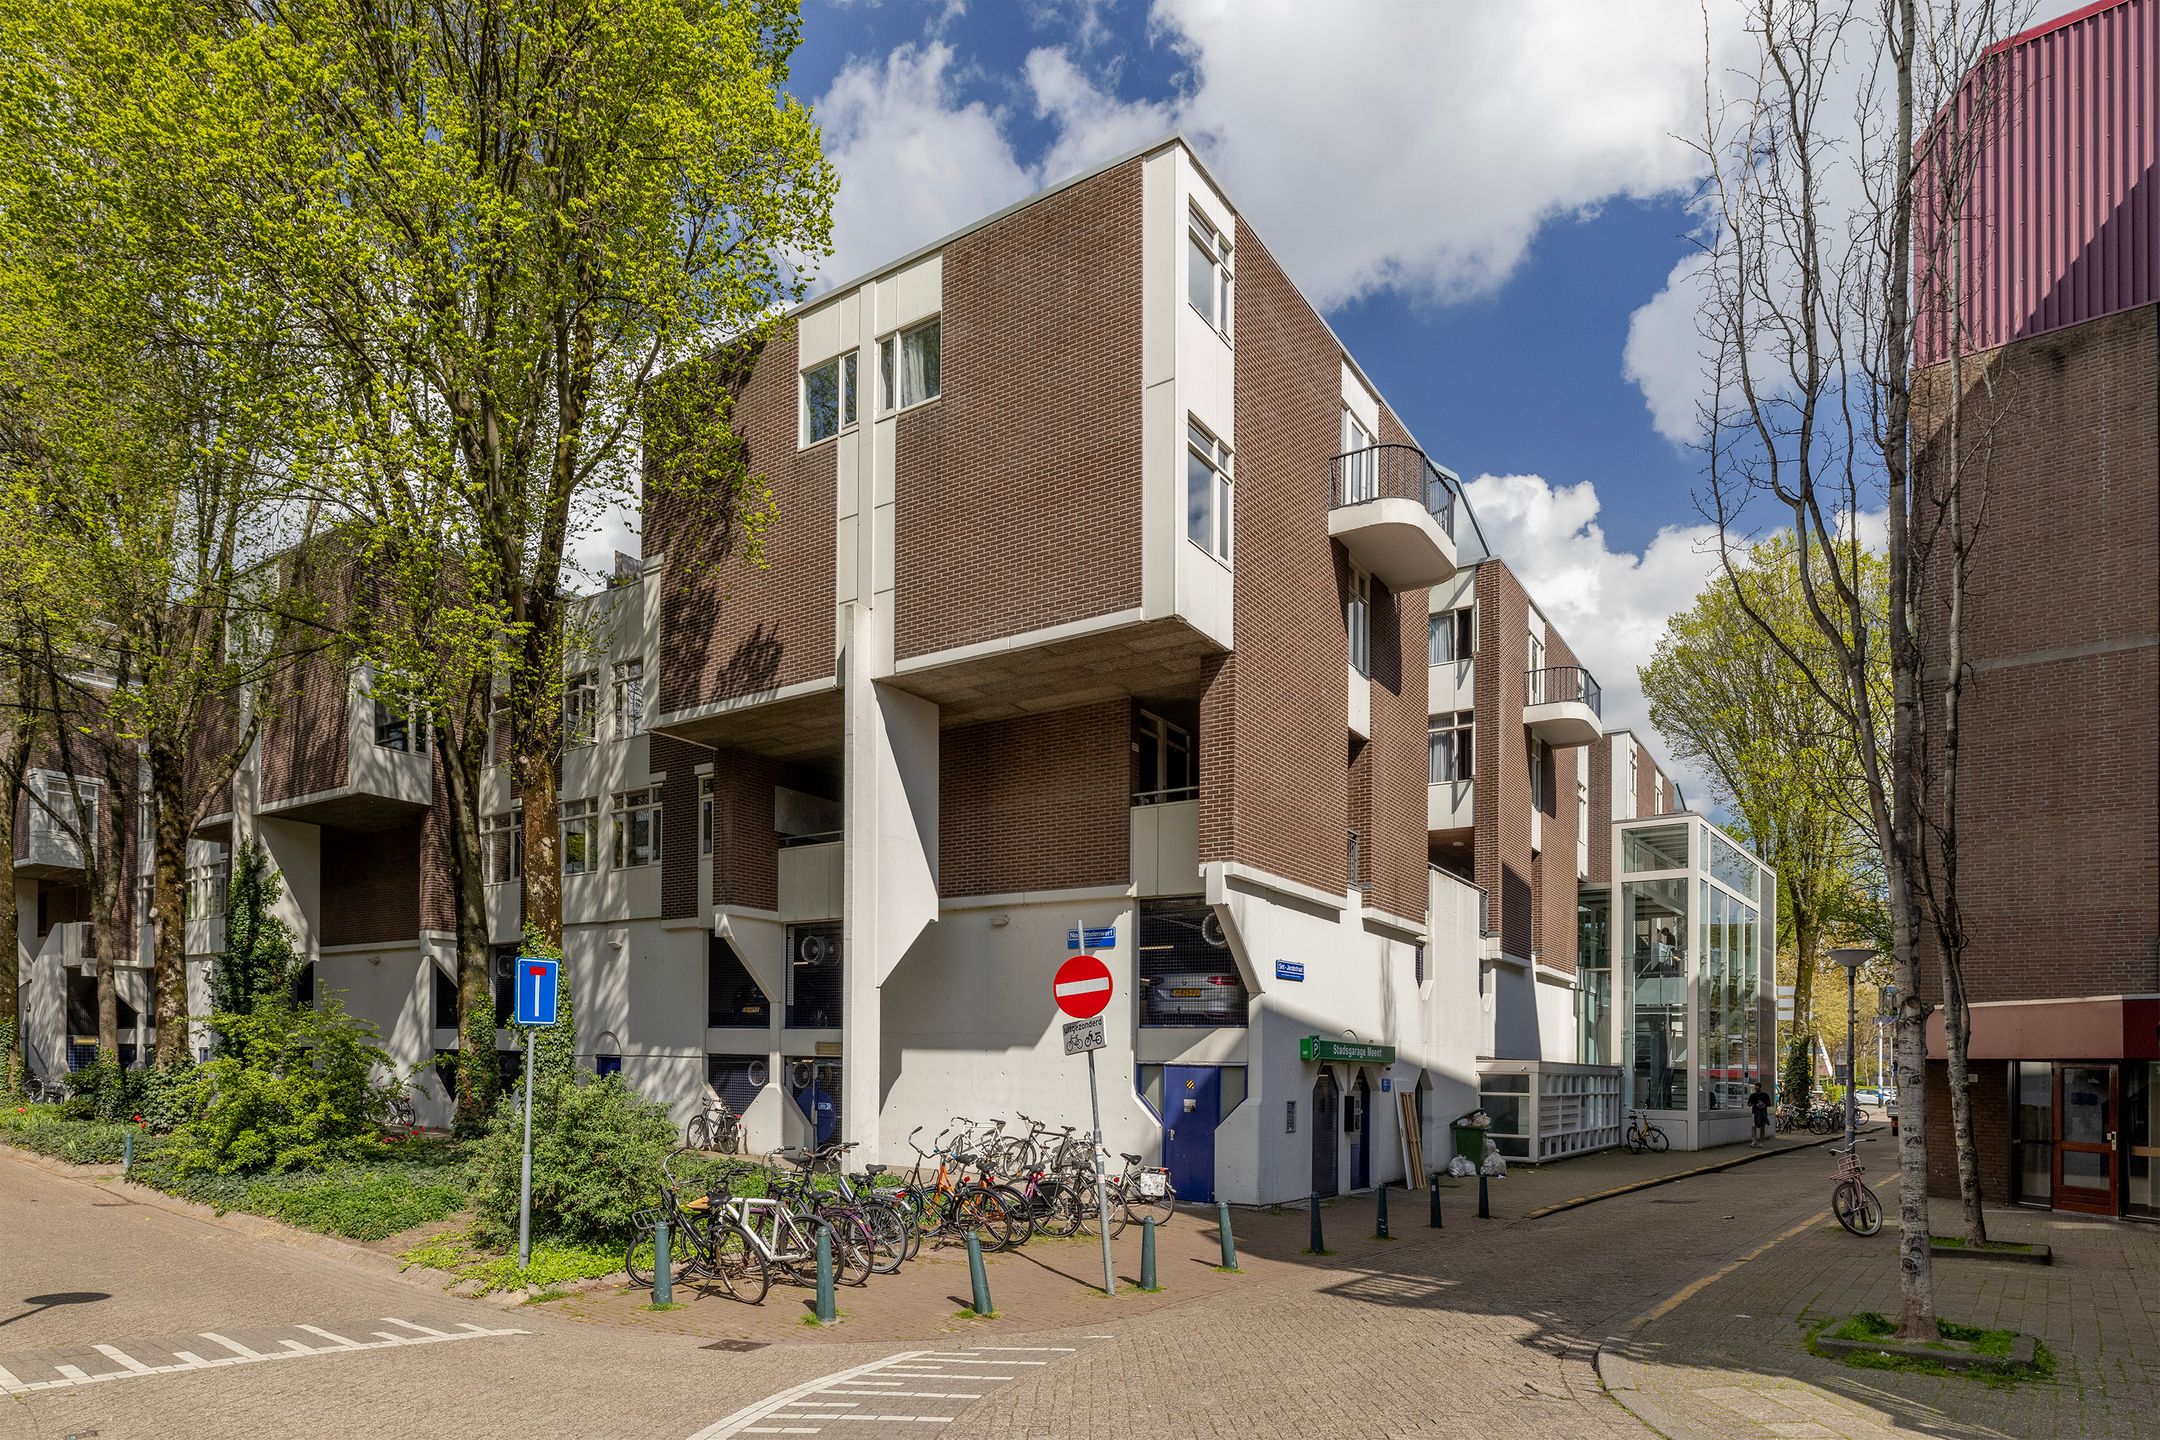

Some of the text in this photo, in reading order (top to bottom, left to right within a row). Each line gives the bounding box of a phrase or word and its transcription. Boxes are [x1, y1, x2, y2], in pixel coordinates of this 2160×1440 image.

[1064, 1018, 1102, 1034] uitgezonderd
[1314, 1043, 1318, 1054] P
[1333, 1044, 1382, 1058] Stadsgarage Meent
